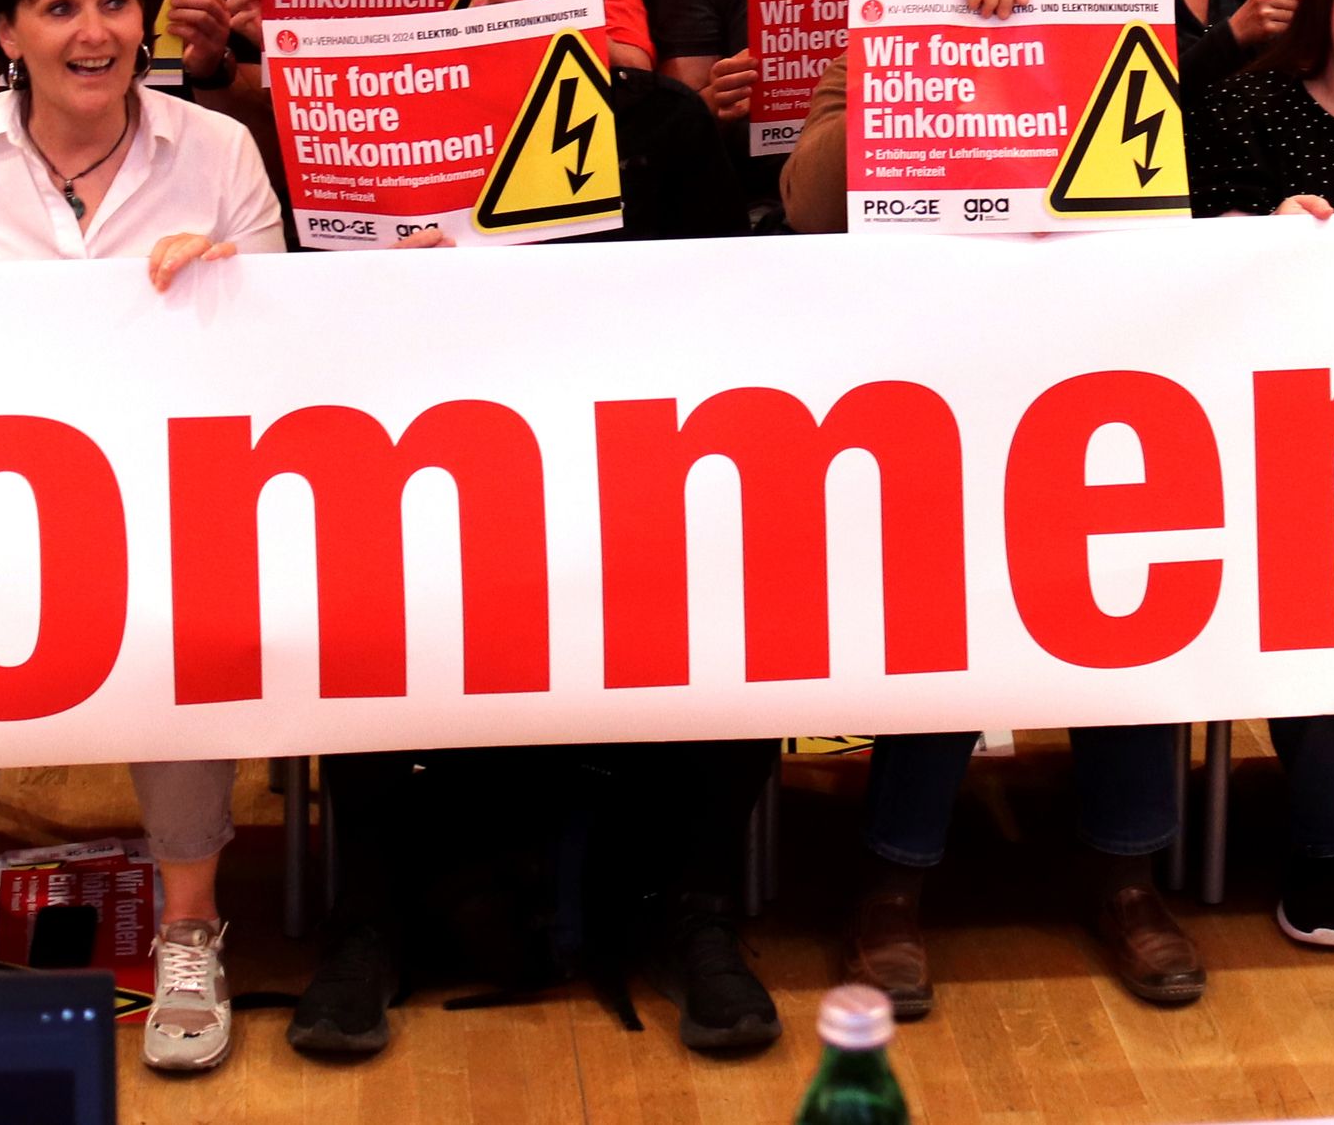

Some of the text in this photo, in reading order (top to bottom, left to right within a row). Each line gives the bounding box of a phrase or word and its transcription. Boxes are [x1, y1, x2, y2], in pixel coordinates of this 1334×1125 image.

[1041, 2, 1059, 14] UND
[1062, 2, 1159, 13] ELEKTRONIKINDUSTRIE
[302, 8, 588, 48] KV-VERHANDLUNGEN 2024 ELEKTRO- UND ELEKTRONIKINDUSTRIE
[863, 32, 1045, 70] Wir fordern
[283, 62, 471, 99] Wir fordern
[863, 70, 975, 104] höhere
[289, 101, 399, 133] höhere
[862, 103, 1069, 141] Einkommen!
[295, 124, 496, 167] Einkommen!
[875, 146, 1059, 163] Erhöhung der Lehrlingseinkommen
[310, 167, 485, 190] Erhöhung der Lehrlingseinkommen
[875, 165, 946, 178] Mehr Freizeit
[313, 189, 376, 203] Mehr Freizeit
[864, 198, 1009, 222] PRO-GE gpa
[308, 217, 376, 236] PRO-GE
[115, 869, 144, 956] Wir fordern
